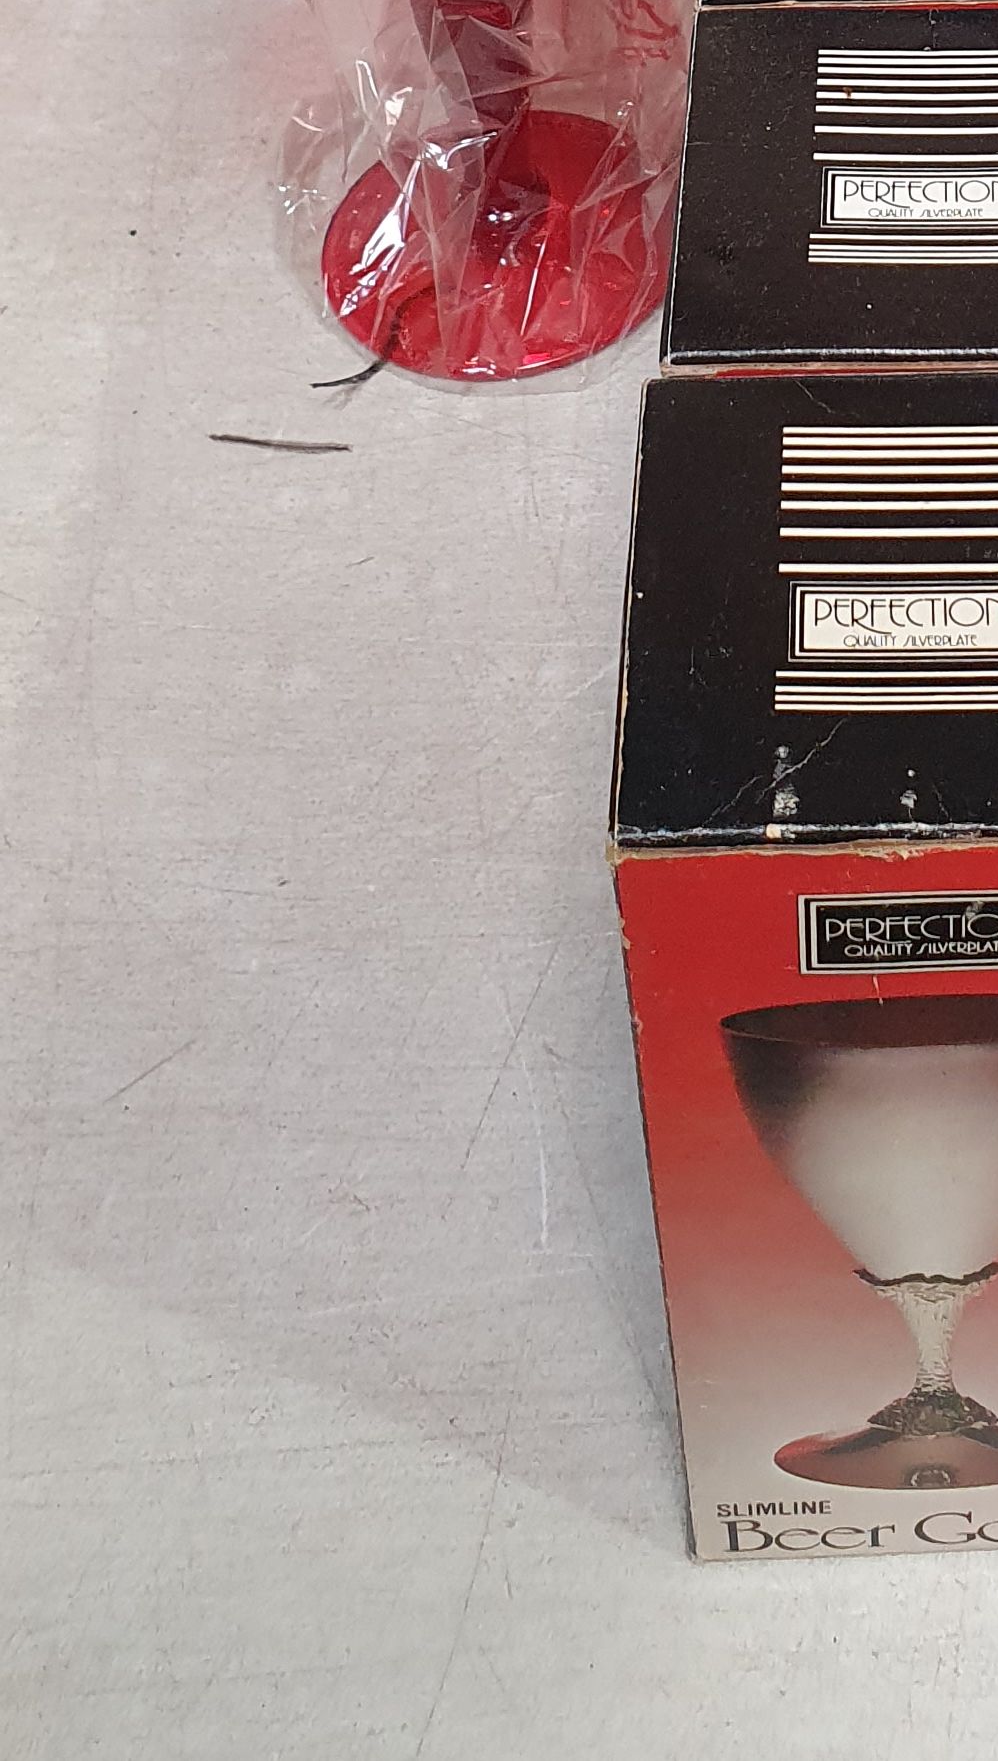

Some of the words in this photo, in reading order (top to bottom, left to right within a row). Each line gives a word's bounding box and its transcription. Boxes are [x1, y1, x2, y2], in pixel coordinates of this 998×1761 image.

[868, 208, 913, 218] QUALITY
[843, 635, 896, 648] QUALITY
[903, 634, 978, 647] SILVERPLATE
[844, 942, 911, 957] QUALITY
[716, 1500, 832, 1517] SLIMLINE
[724, 1518, 896, 1553] Beer
